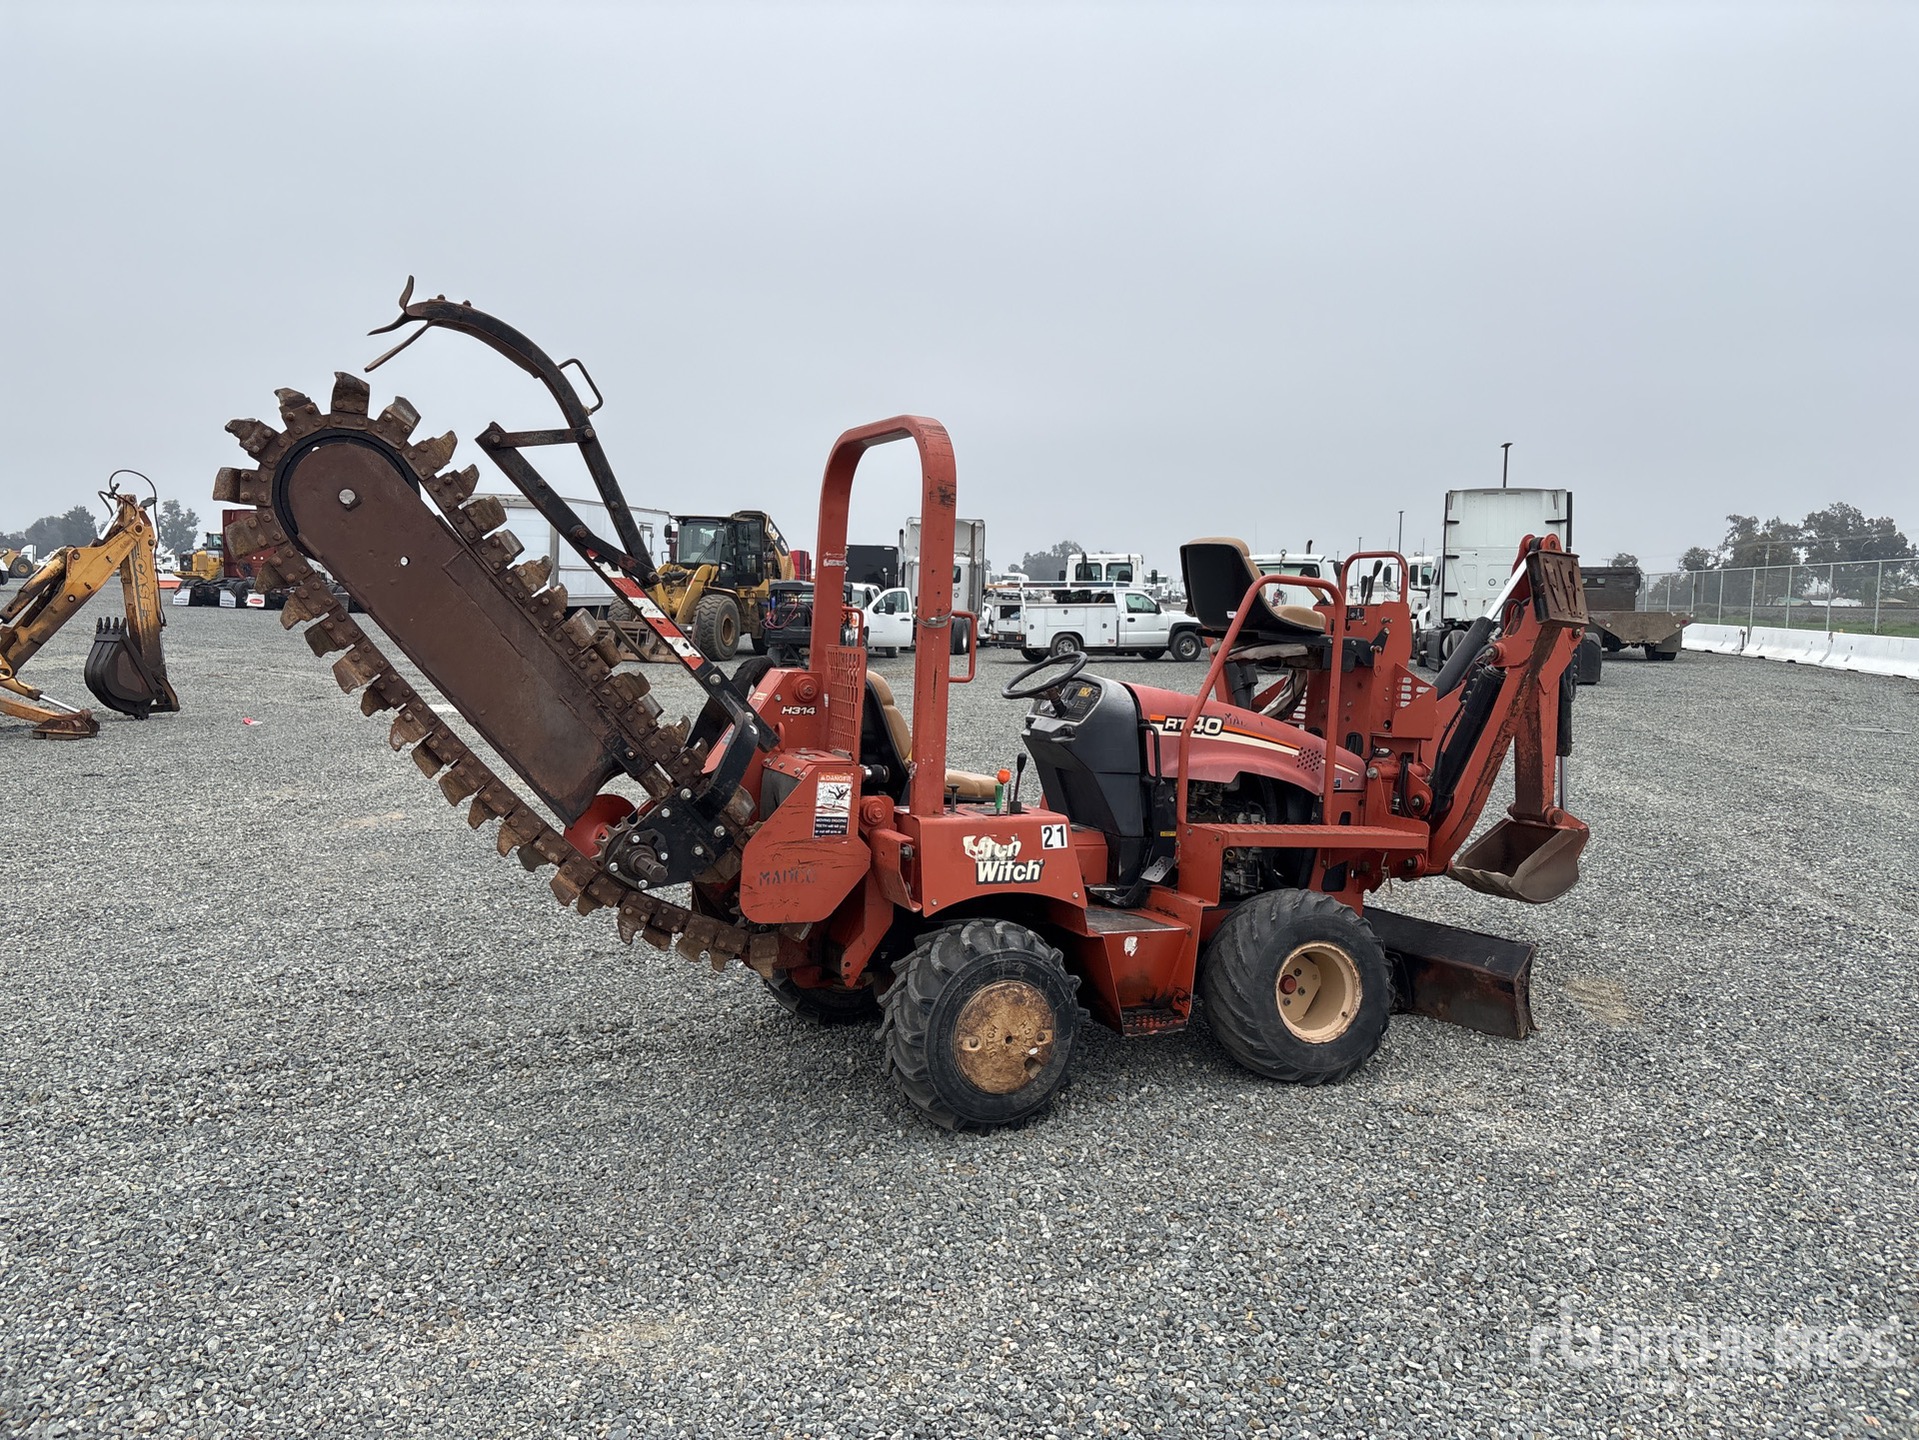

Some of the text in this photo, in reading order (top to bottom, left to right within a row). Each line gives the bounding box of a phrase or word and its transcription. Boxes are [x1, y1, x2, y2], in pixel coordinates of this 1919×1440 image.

[781, 706, 816, 716] H314
[1043, 825, 1065, 848] 21
[977, 860, 1044, 884] Witch
